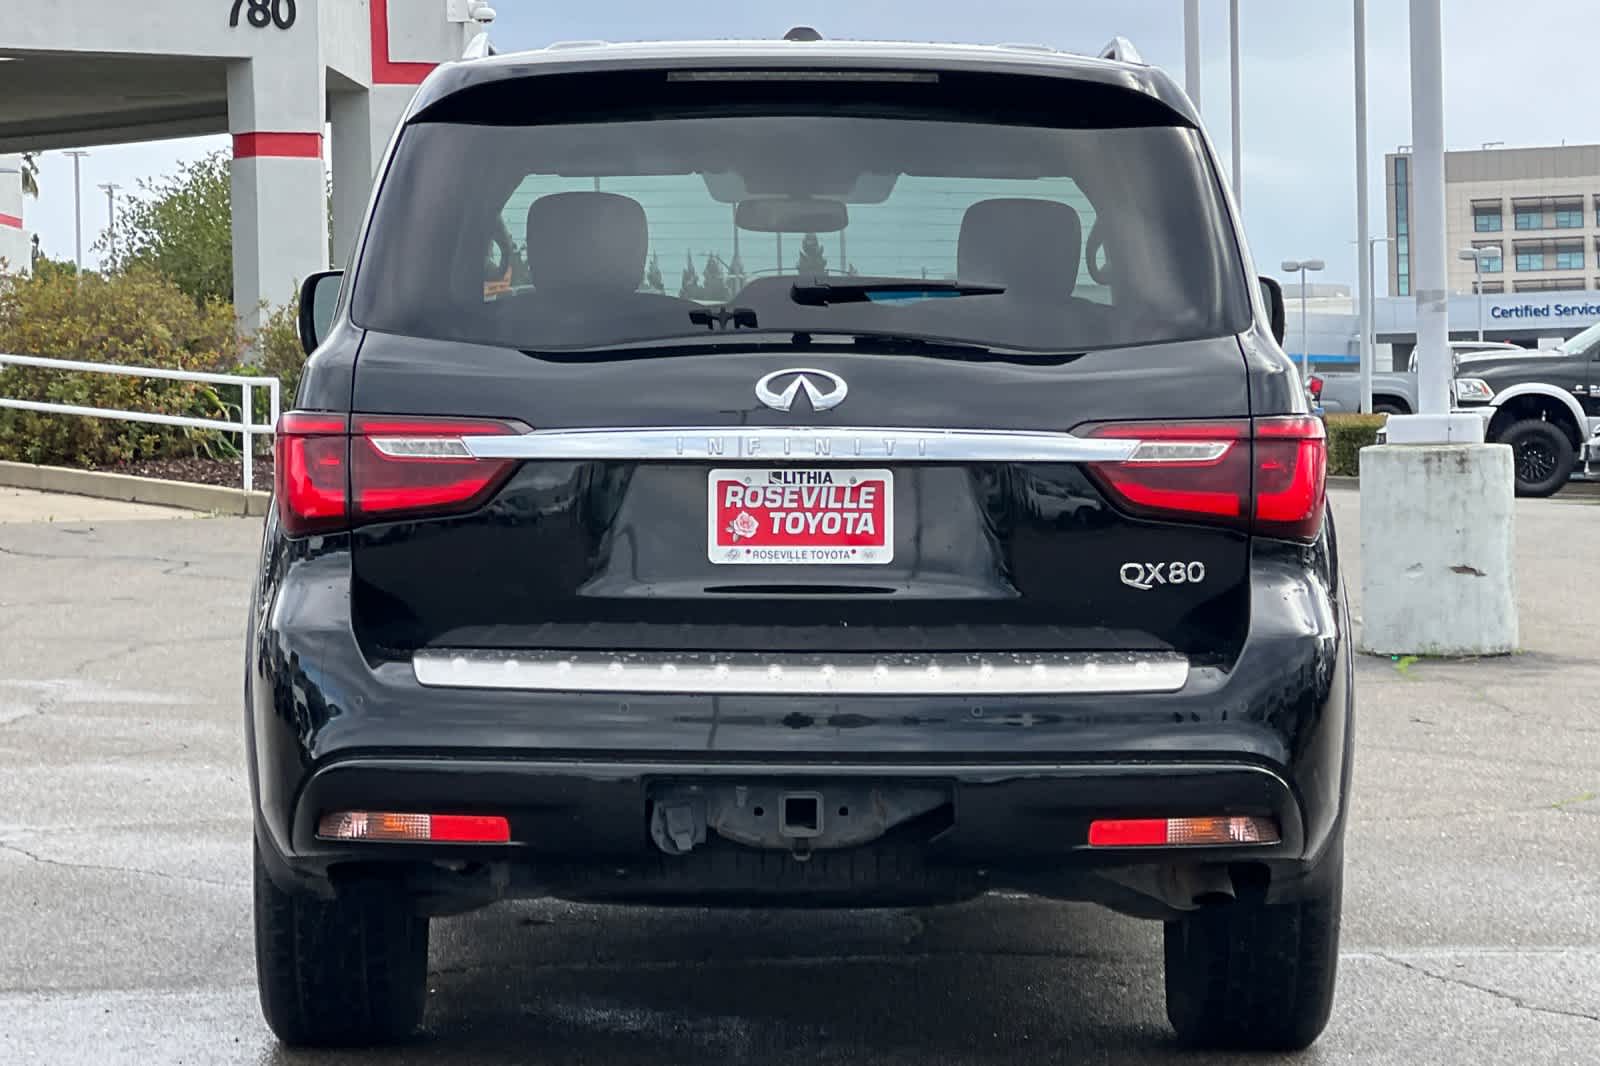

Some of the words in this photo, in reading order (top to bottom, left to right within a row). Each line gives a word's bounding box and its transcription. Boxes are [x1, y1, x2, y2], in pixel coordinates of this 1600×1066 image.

[230, 0, 296, 29] 780
[1491, 304, 1549, 318] Certified
[676, 436, 927, 455] INFINITI
[783, 471, 833, 484] LITHIA
[725, 486, 875, 508] ROSEVILLE
[769, 512, 875, 534] TOYOTA
[752, 551, 808, 560] ROSEVILLE
[810, 551, 850, 560] TOYOTA
[1120, 561, 1205, 590] QX80
